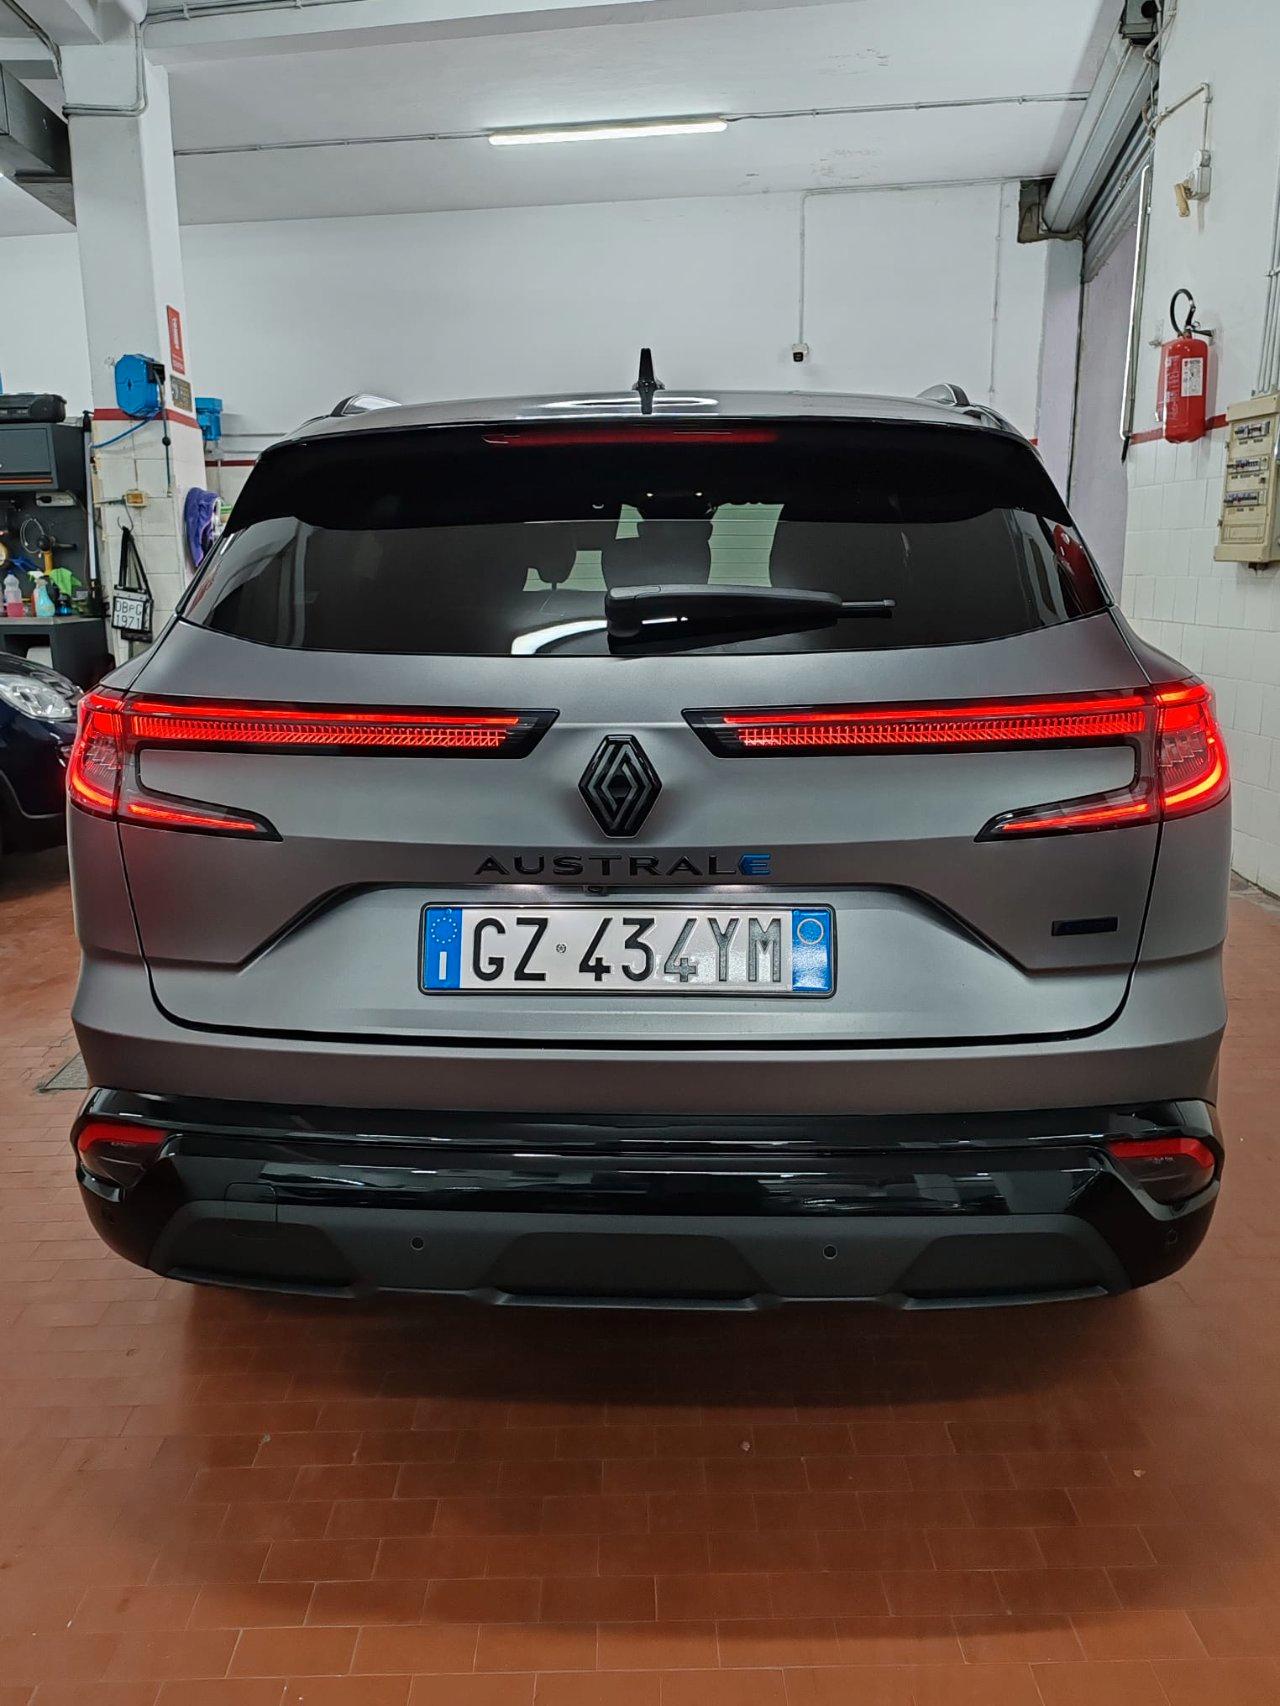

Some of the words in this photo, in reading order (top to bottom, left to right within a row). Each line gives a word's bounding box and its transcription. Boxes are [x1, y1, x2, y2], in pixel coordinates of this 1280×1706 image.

[116, 614, 140, 629] 1971
[474, 853, 772, 877] AUSTRALE
[472, 916, 549, 982] GZ
[578, 916, 782, 983] 434YM
